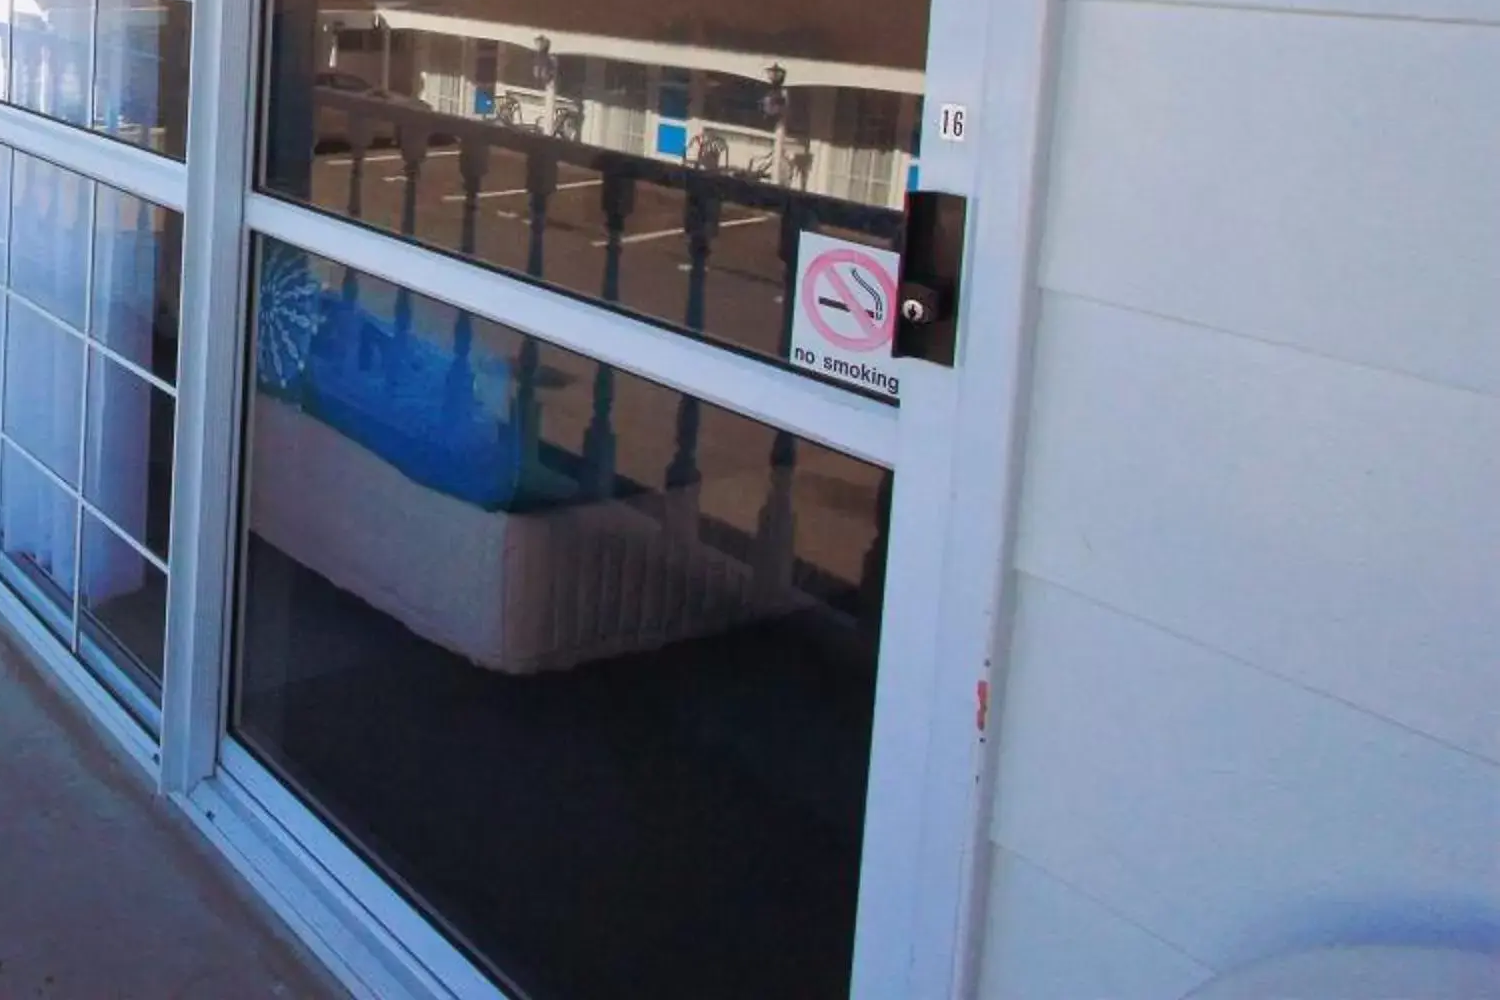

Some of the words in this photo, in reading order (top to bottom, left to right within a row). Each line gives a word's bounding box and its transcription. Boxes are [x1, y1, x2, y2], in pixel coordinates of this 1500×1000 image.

[943, 109, 964, 137] 16
[794, 346, 816, 365] no
[822, 355, 900, 395] smoking
